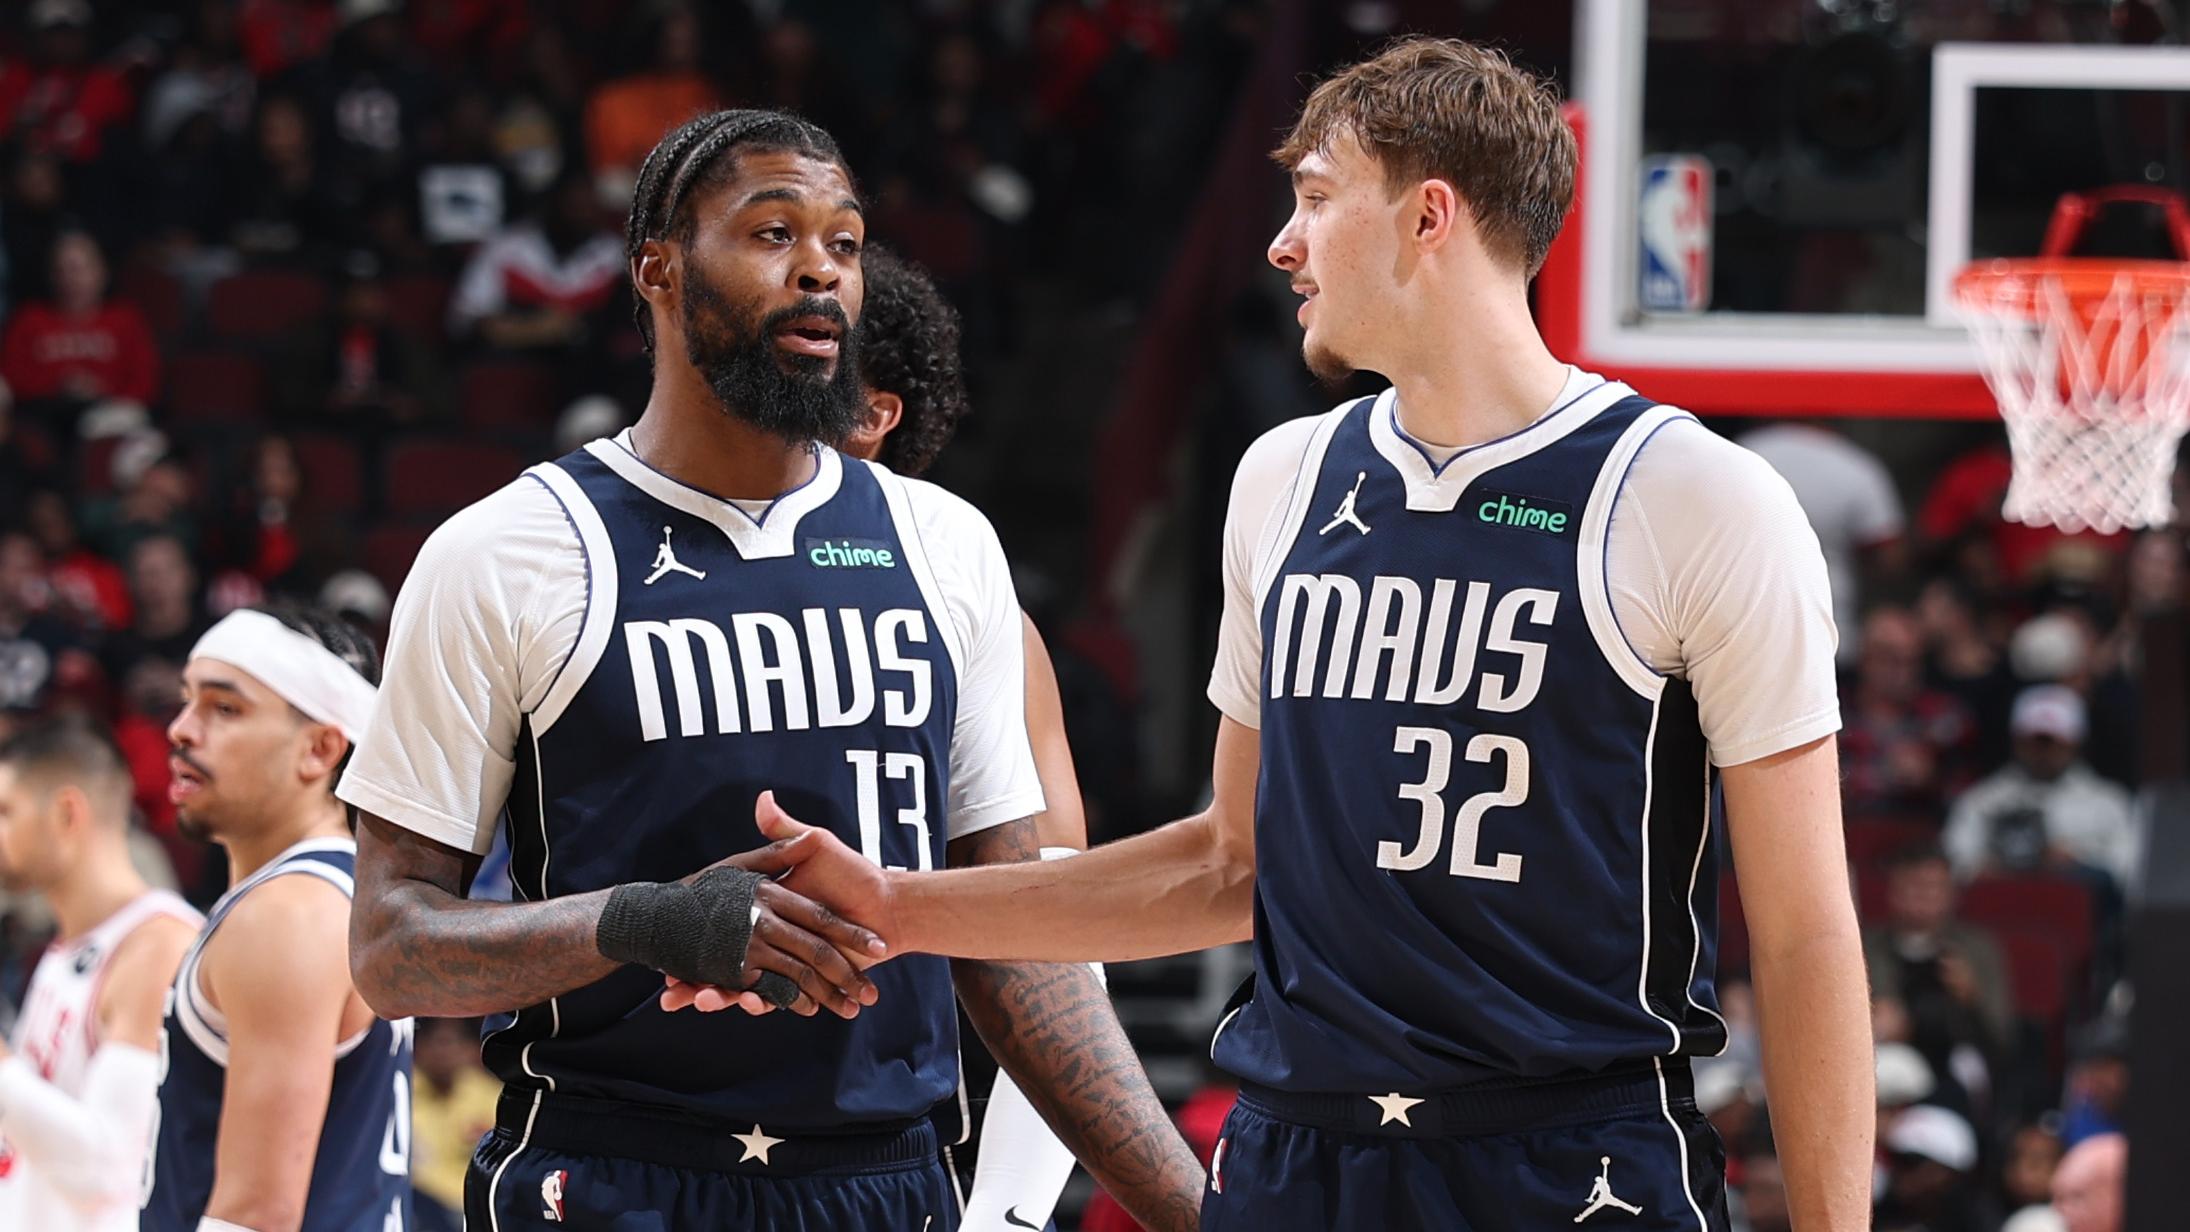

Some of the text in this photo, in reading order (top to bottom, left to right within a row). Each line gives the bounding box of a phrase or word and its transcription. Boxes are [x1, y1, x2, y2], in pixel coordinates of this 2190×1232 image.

[810, 540, 896, 568] chime
[1478, 495, 1567, 533] chime
[624, 608, 933, 742] MAVS
[1271, 573, 1561, 713] MAVS
[845, 749, 932, 873] 13
[1376, 725, 1530, 883] 32
